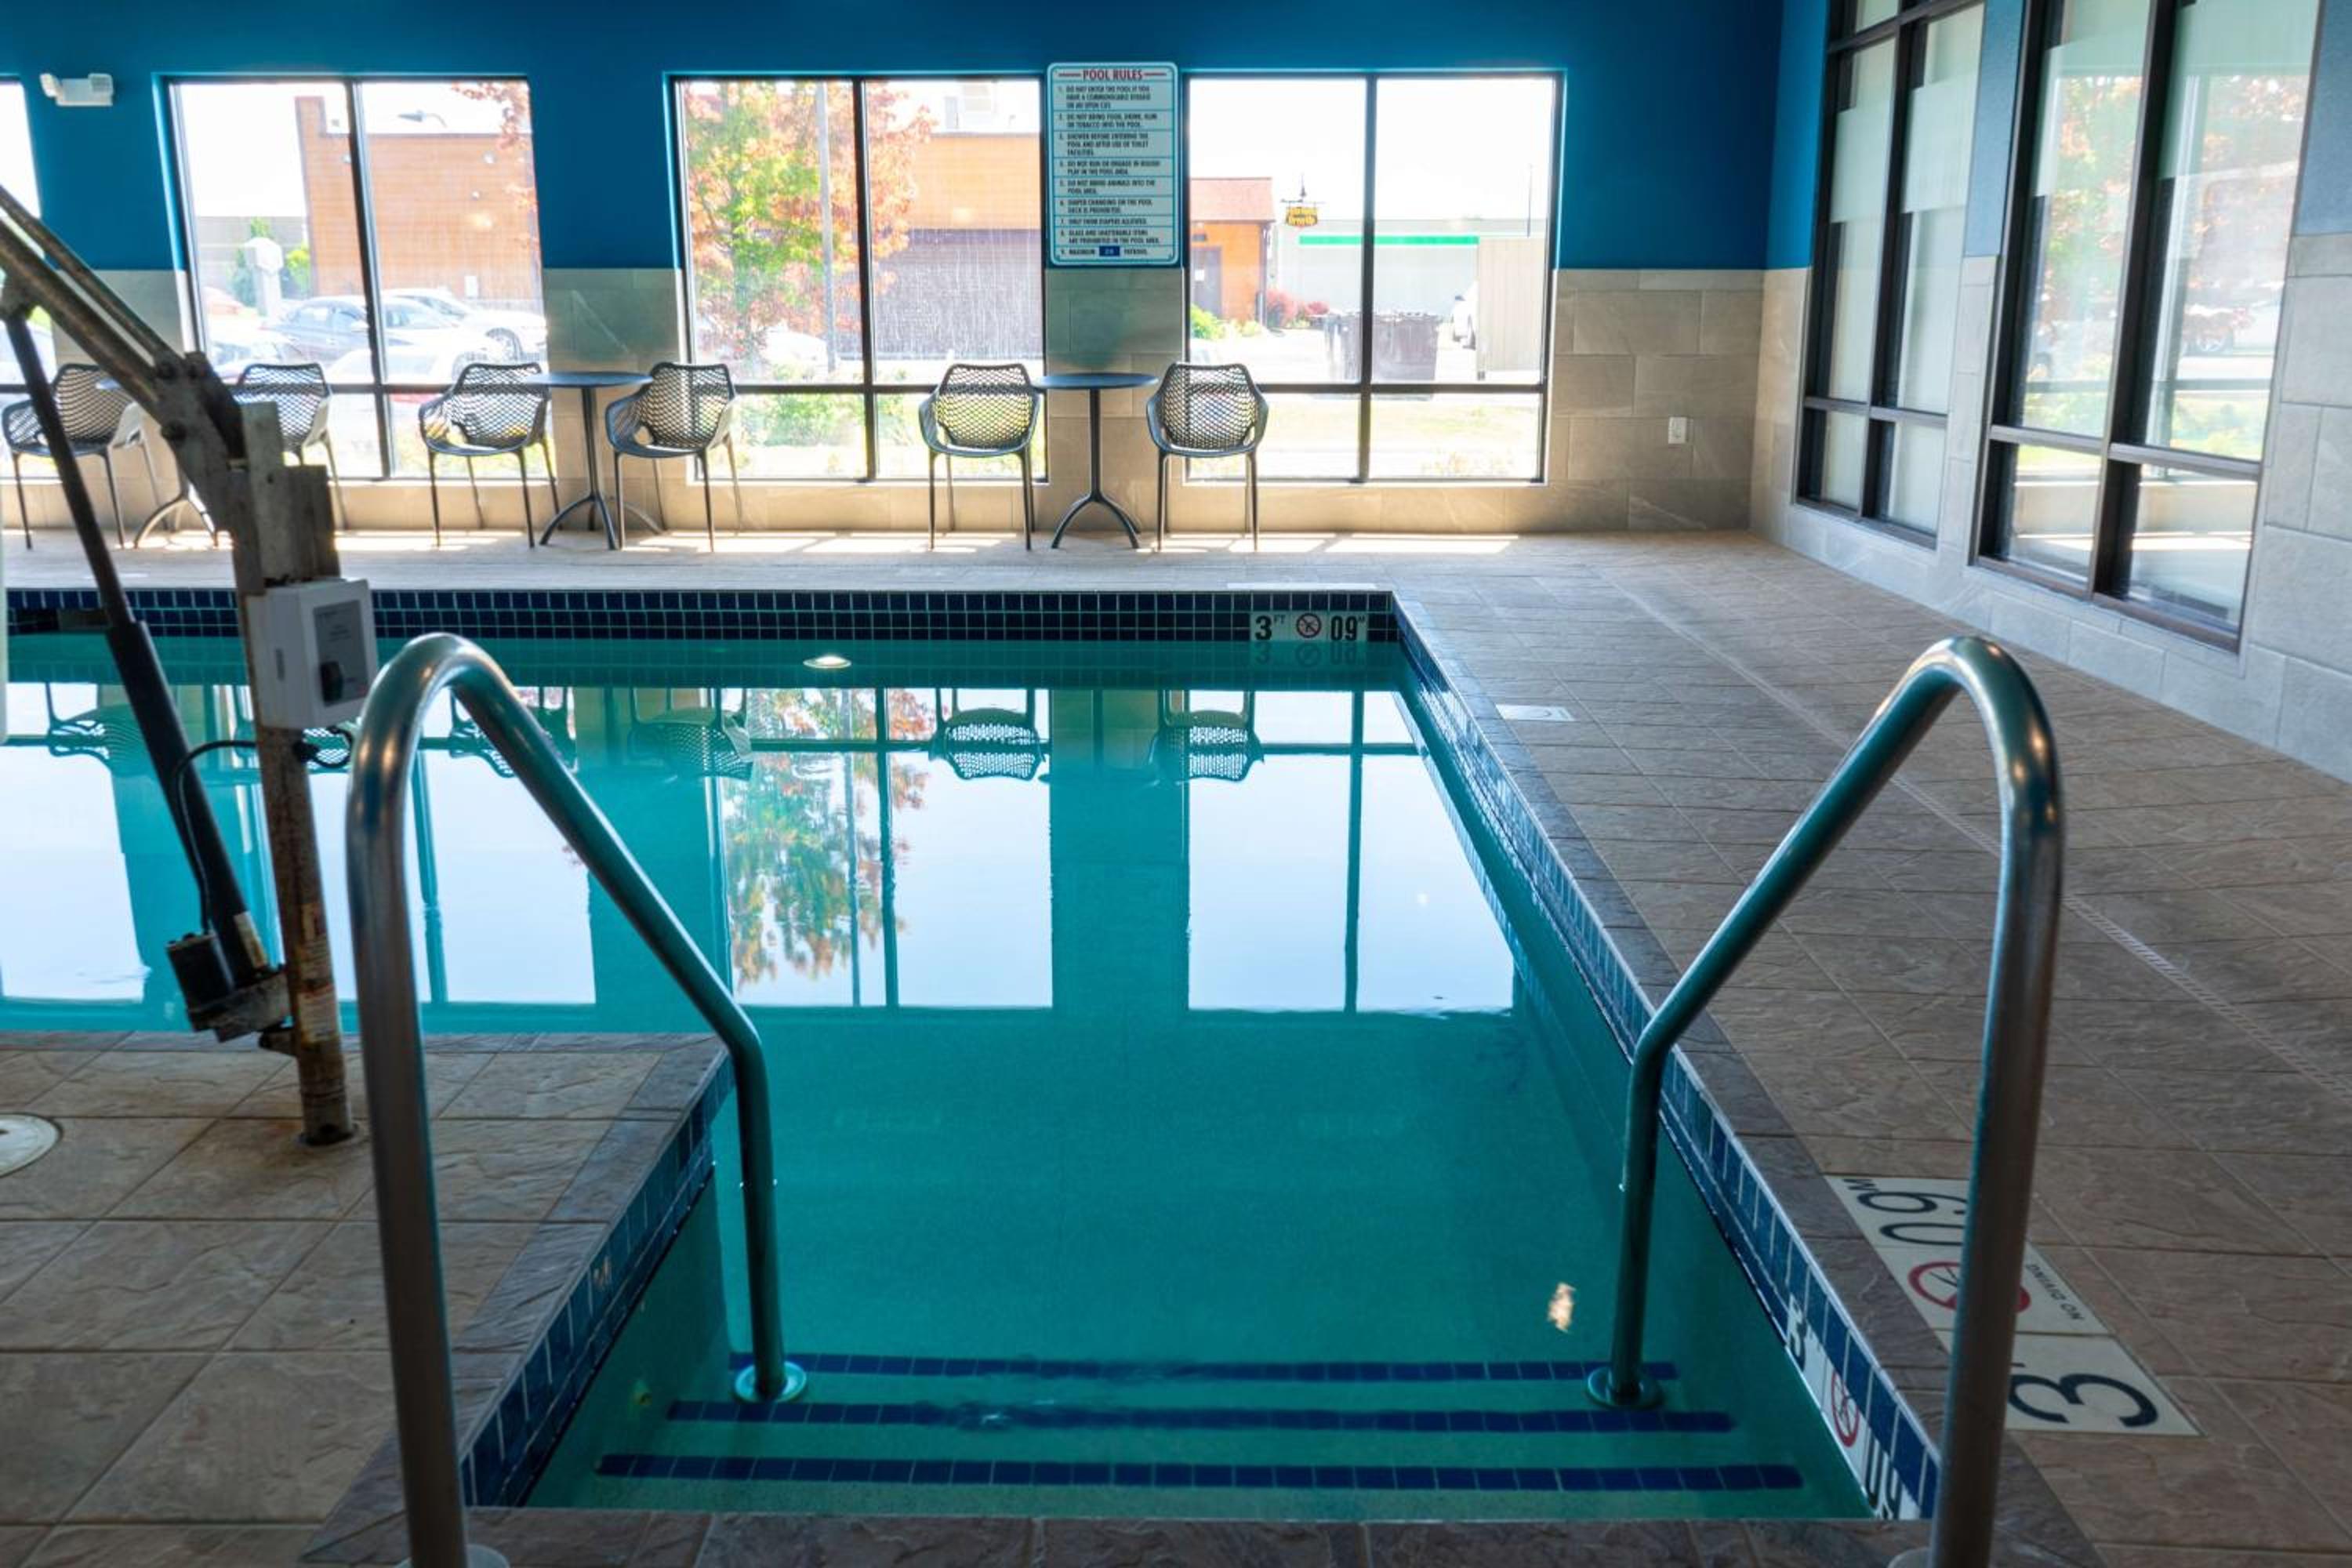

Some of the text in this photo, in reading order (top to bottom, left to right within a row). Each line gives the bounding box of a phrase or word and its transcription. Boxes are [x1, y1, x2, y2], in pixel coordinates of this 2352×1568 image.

[1083, 68, 1142, 82] POOL RULES
[1255, 615, 1272, 641] 3
[1331, 615, 1358, 641] 09
[2024, 1264, 2085, 1320] NO DIVING
[2006, 1373, 2158, 1428] 3
